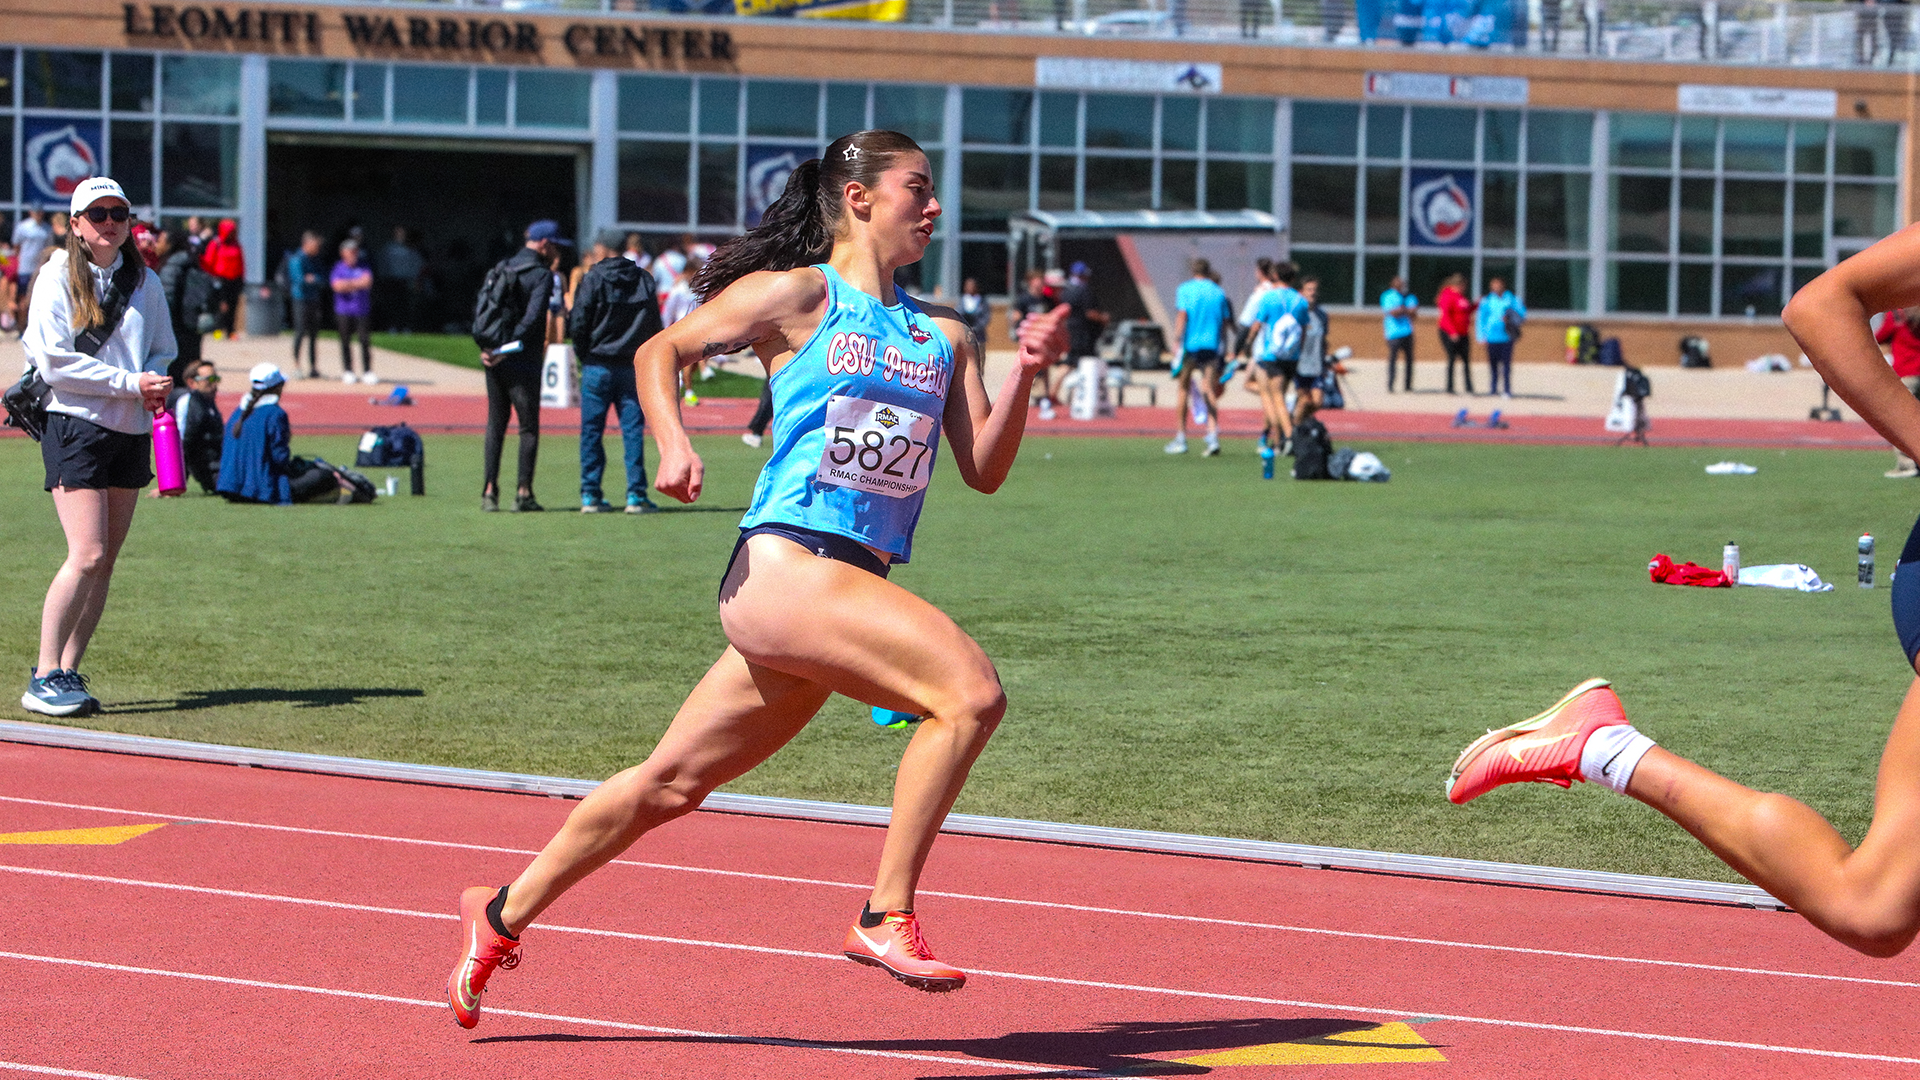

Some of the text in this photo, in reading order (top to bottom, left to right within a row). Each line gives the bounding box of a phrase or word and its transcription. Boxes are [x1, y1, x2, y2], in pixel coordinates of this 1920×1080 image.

[124, 3, 733, 59] LEOMITI WARRIOR CENTER
[827, 332, 877, 377] CSU
[546, 362, 558, 388] 6
[877, 412, 899, 425] RMAC
[829, 426, 929, 480] 5827
[829, 468, 918, 493] RMAC CHAMPIONSHIP
